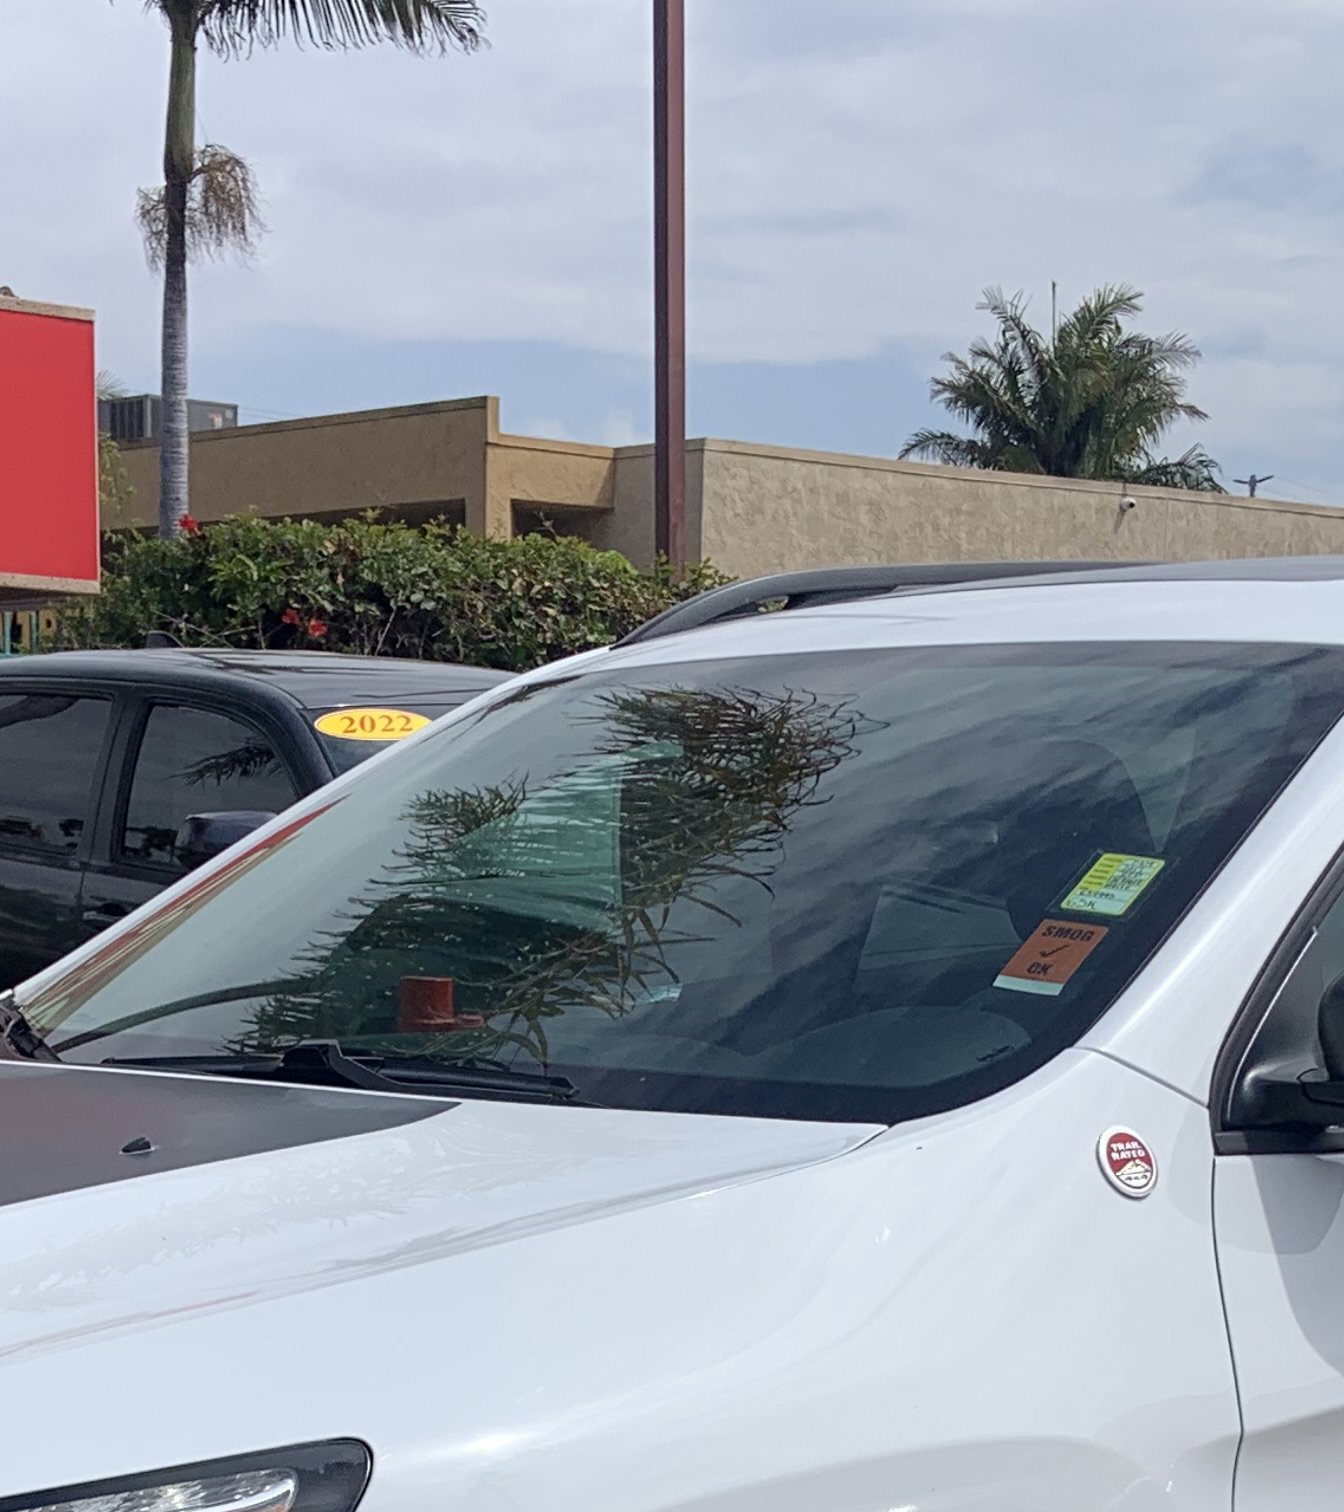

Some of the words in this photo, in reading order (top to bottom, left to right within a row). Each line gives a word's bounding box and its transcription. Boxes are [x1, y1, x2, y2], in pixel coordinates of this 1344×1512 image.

[340, 714, 414, 734] 2022
[1042, 925, 1095, 942] SMOG
[1026, 961, 1053, 976] OK
